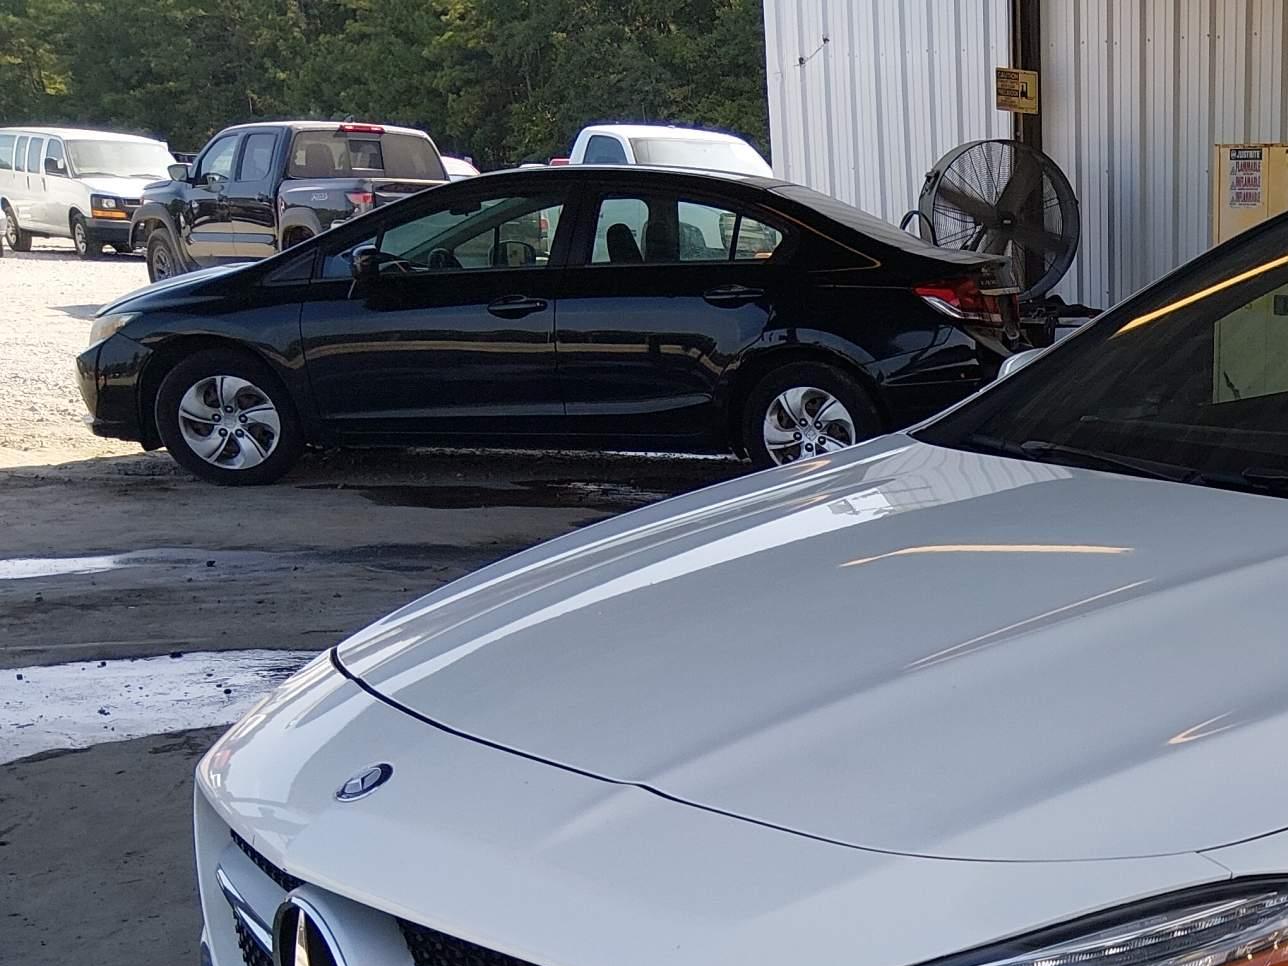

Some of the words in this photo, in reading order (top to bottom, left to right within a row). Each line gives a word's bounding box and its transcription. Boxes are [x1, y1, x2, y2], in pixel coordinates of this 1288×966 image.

[997, 71, 1018, 80] CAUTION
[1237, 150, 1262, 159] JUSTRITE
[1236, 160, 1261, 172] FLAMMABLE
